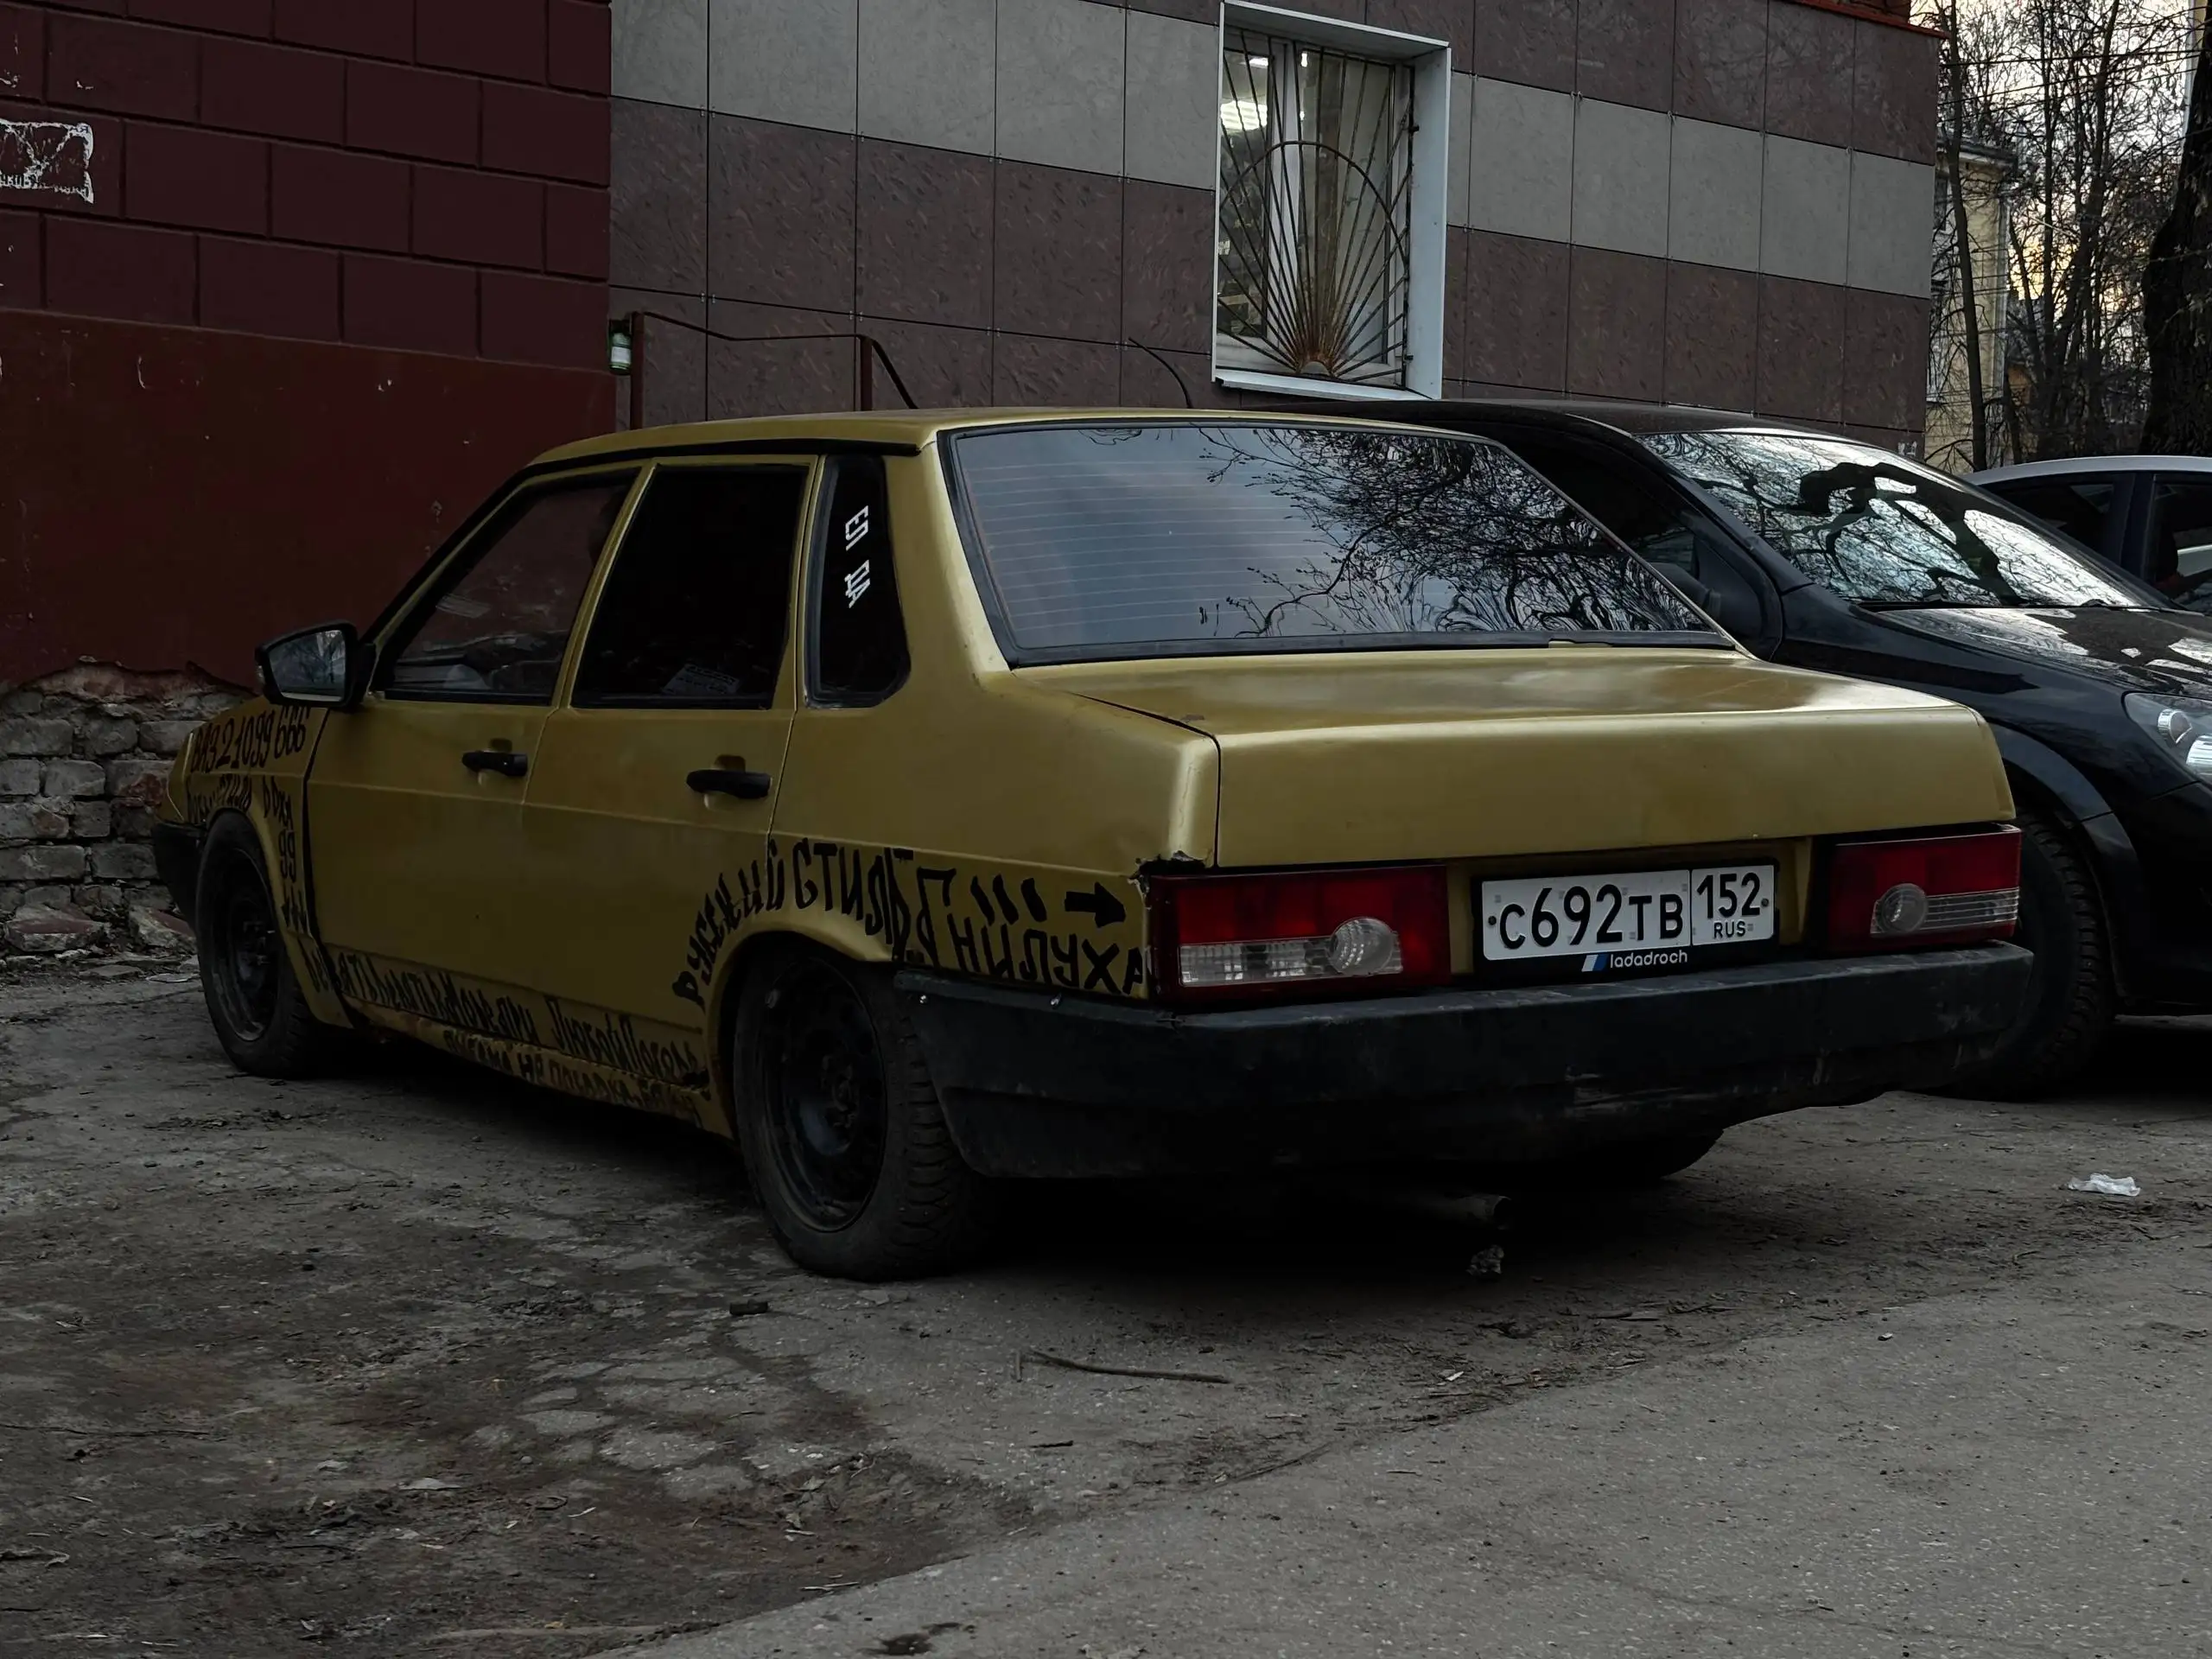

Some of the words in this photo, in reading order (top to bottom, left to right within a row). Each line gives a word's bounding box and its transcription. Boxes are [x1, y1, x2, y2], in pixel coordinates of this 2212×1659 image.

[216, 710, 276, 768] 21099
[1499, 883, 1684, 949] С692ТВ
[1697, 872, 1760, 919] 152
[1713, 919, 1746, 939] RUS
[1610, 948, 1688, 969] ladadroch
